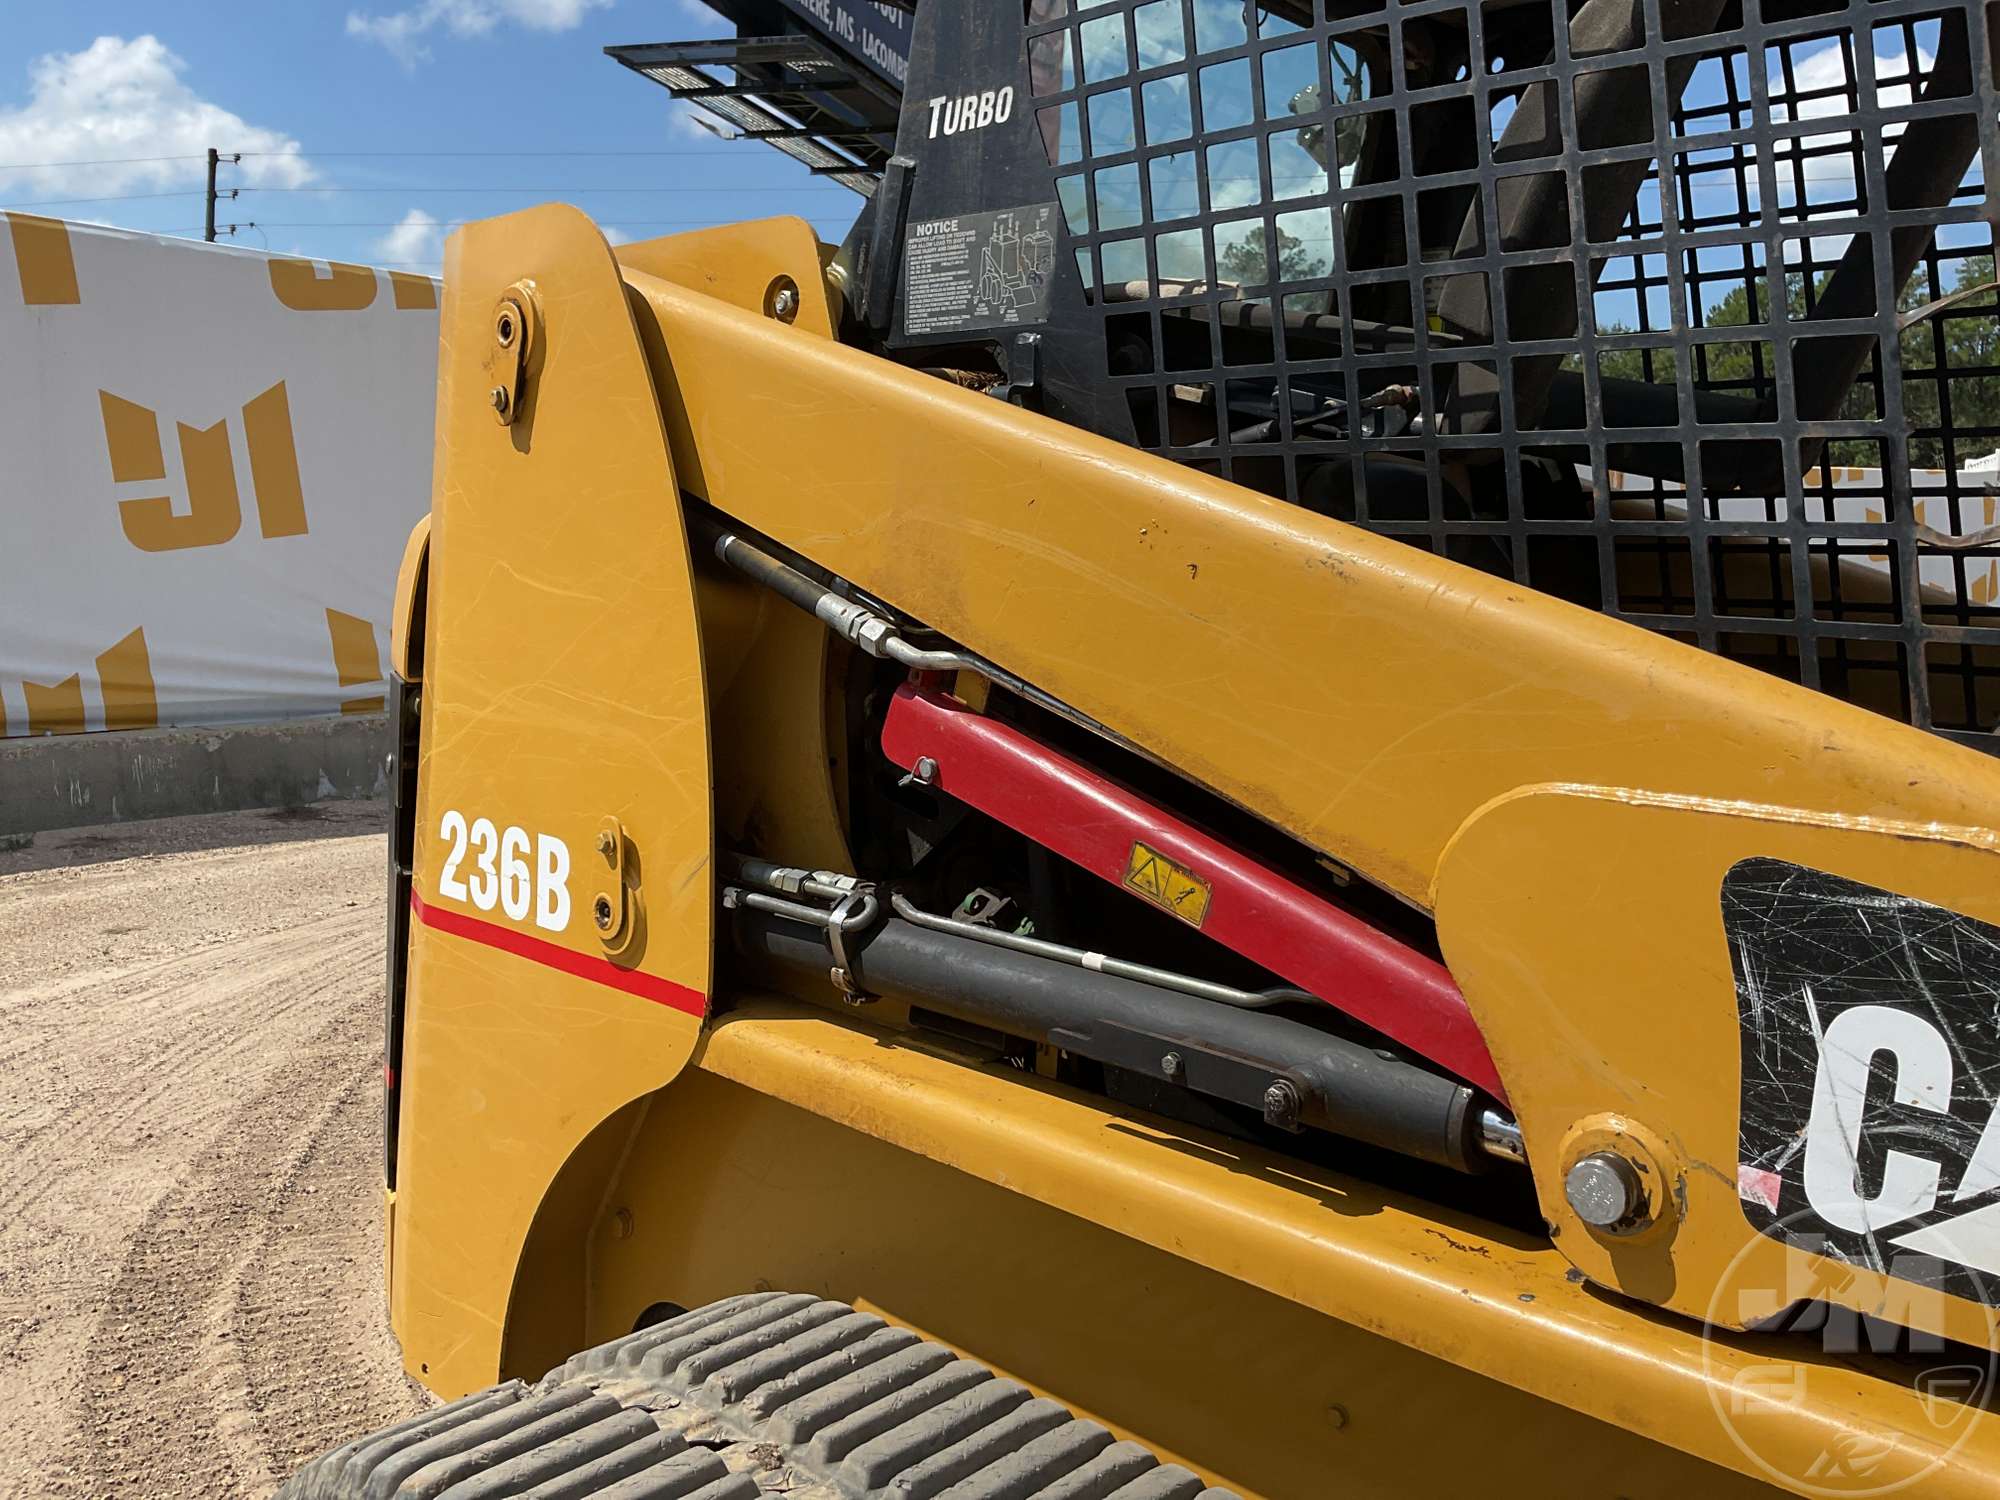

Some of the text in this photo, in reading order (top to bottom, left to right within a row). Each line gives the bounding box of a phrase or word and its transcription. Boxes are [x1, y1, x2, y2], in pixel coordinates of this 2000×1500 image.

[836, 6, 855, 43] MS
[928, 86, 1014, 140] TURBO
[916, 220, 959, 236] NOTICE
[439, 810, 572, 932] 236B
